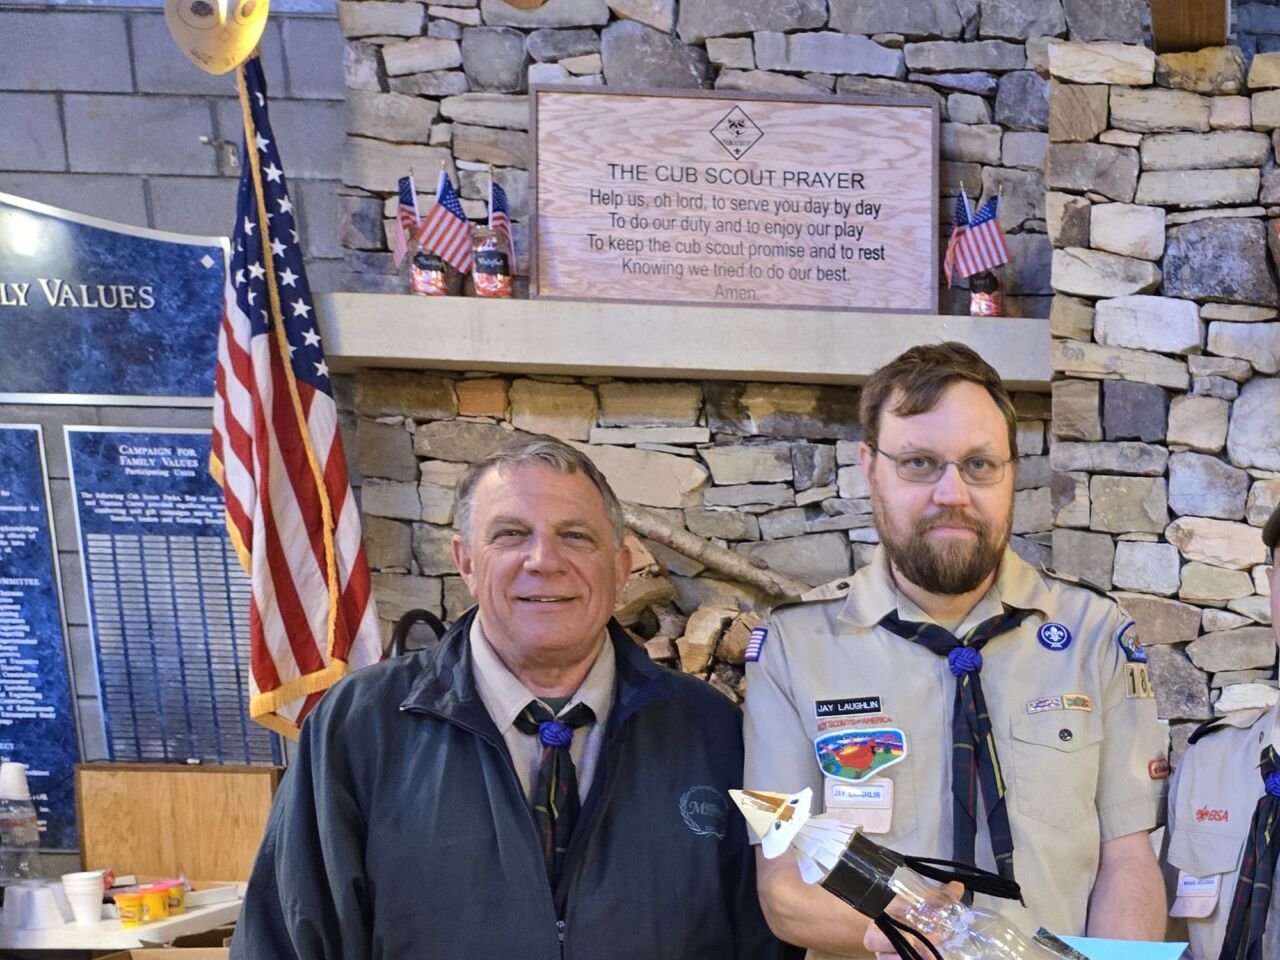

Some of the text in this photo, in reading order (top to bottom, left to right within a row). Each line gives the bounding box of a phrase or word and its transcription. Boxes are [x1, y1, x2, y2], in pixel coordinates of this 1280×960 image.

[607, 163, 865, 190] THE CUB SCOUT PRAYER
[590, 188, 881, 220] Help us, oh lord, to serve you day by day
[608, 212, 864, 241] To do our duty and to enjoy our play
[586, 233, 885, 260] To keep the cub scout promise and to rest
[621, 257, 850, 281] Knowing we tried to do our best.
[38, 278, 156, 309] VALUES
[119, 445, 197, 457] CAMPAIGN FOR
[119, 456, 199, 467] FAMILY VALUES
[1129, 667, 1155, 694] 18
[818, 701, 879, 713] JAY LAUGHLIN
[1208, 810, 1229, 822] BSA
